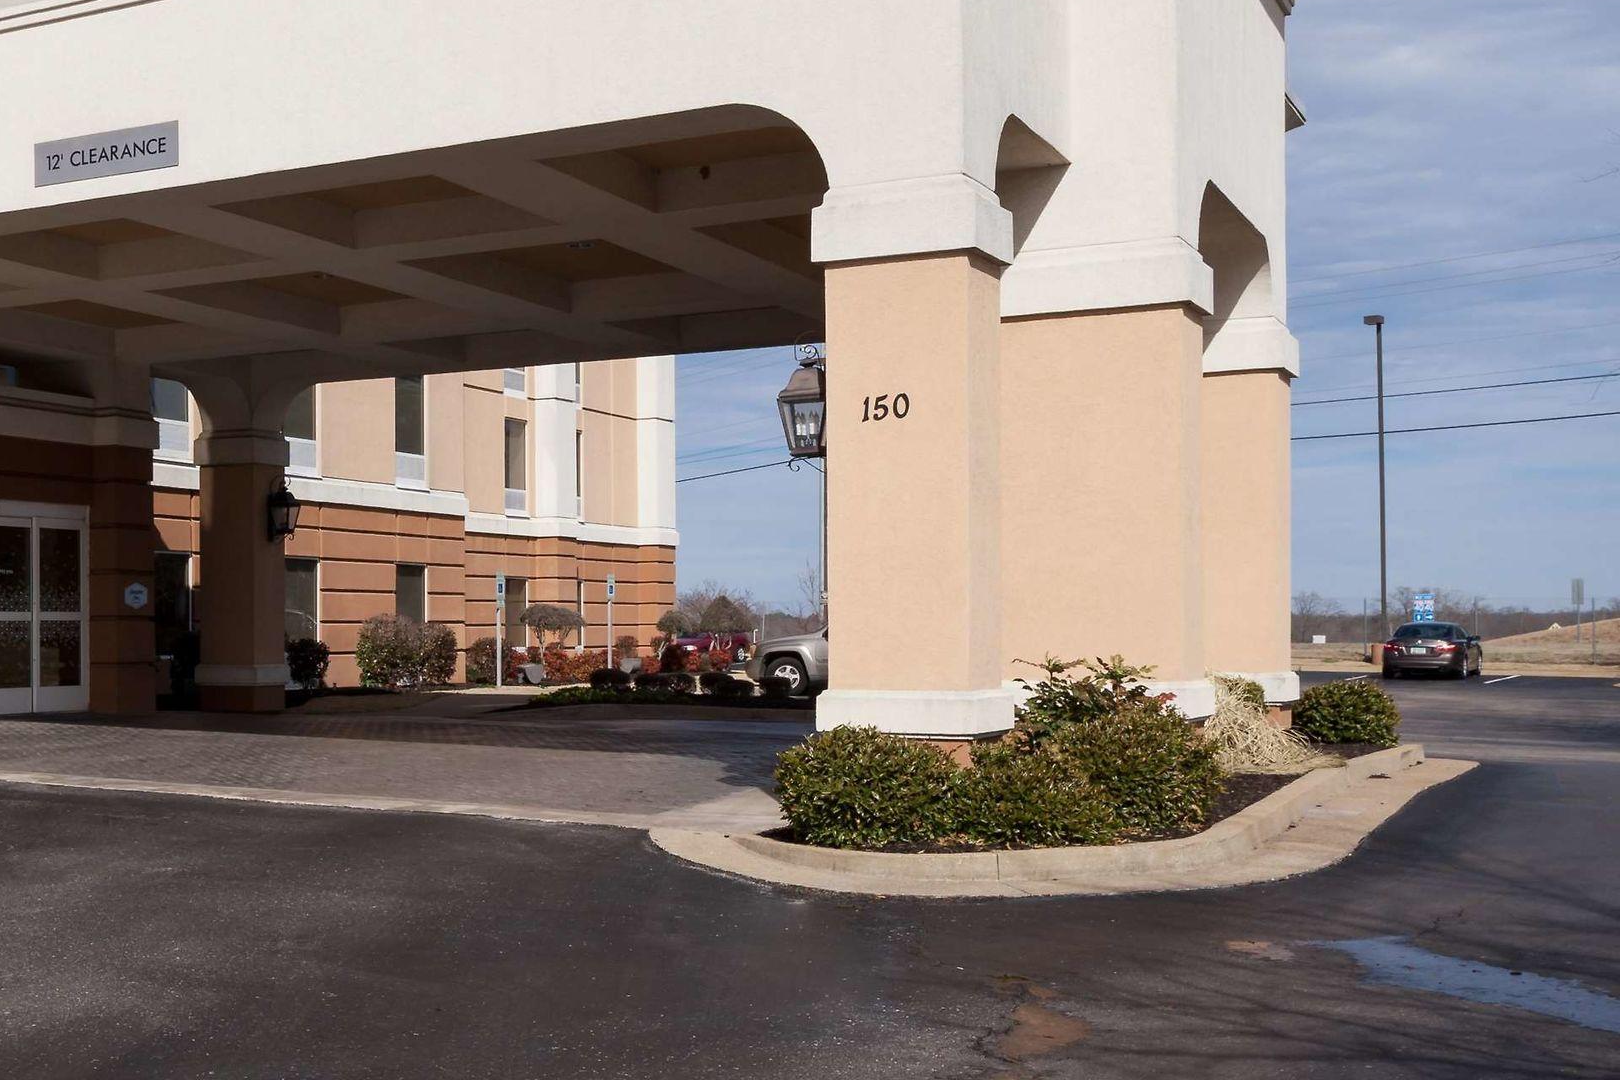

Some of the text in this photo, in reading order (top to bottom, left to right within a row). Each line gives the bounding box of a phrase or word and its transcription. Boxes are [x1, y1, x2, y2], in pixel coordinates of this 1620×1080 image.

[46, 136, 167, 171] 12' CLEARANCE
[862, 392, 910, 423] 150
